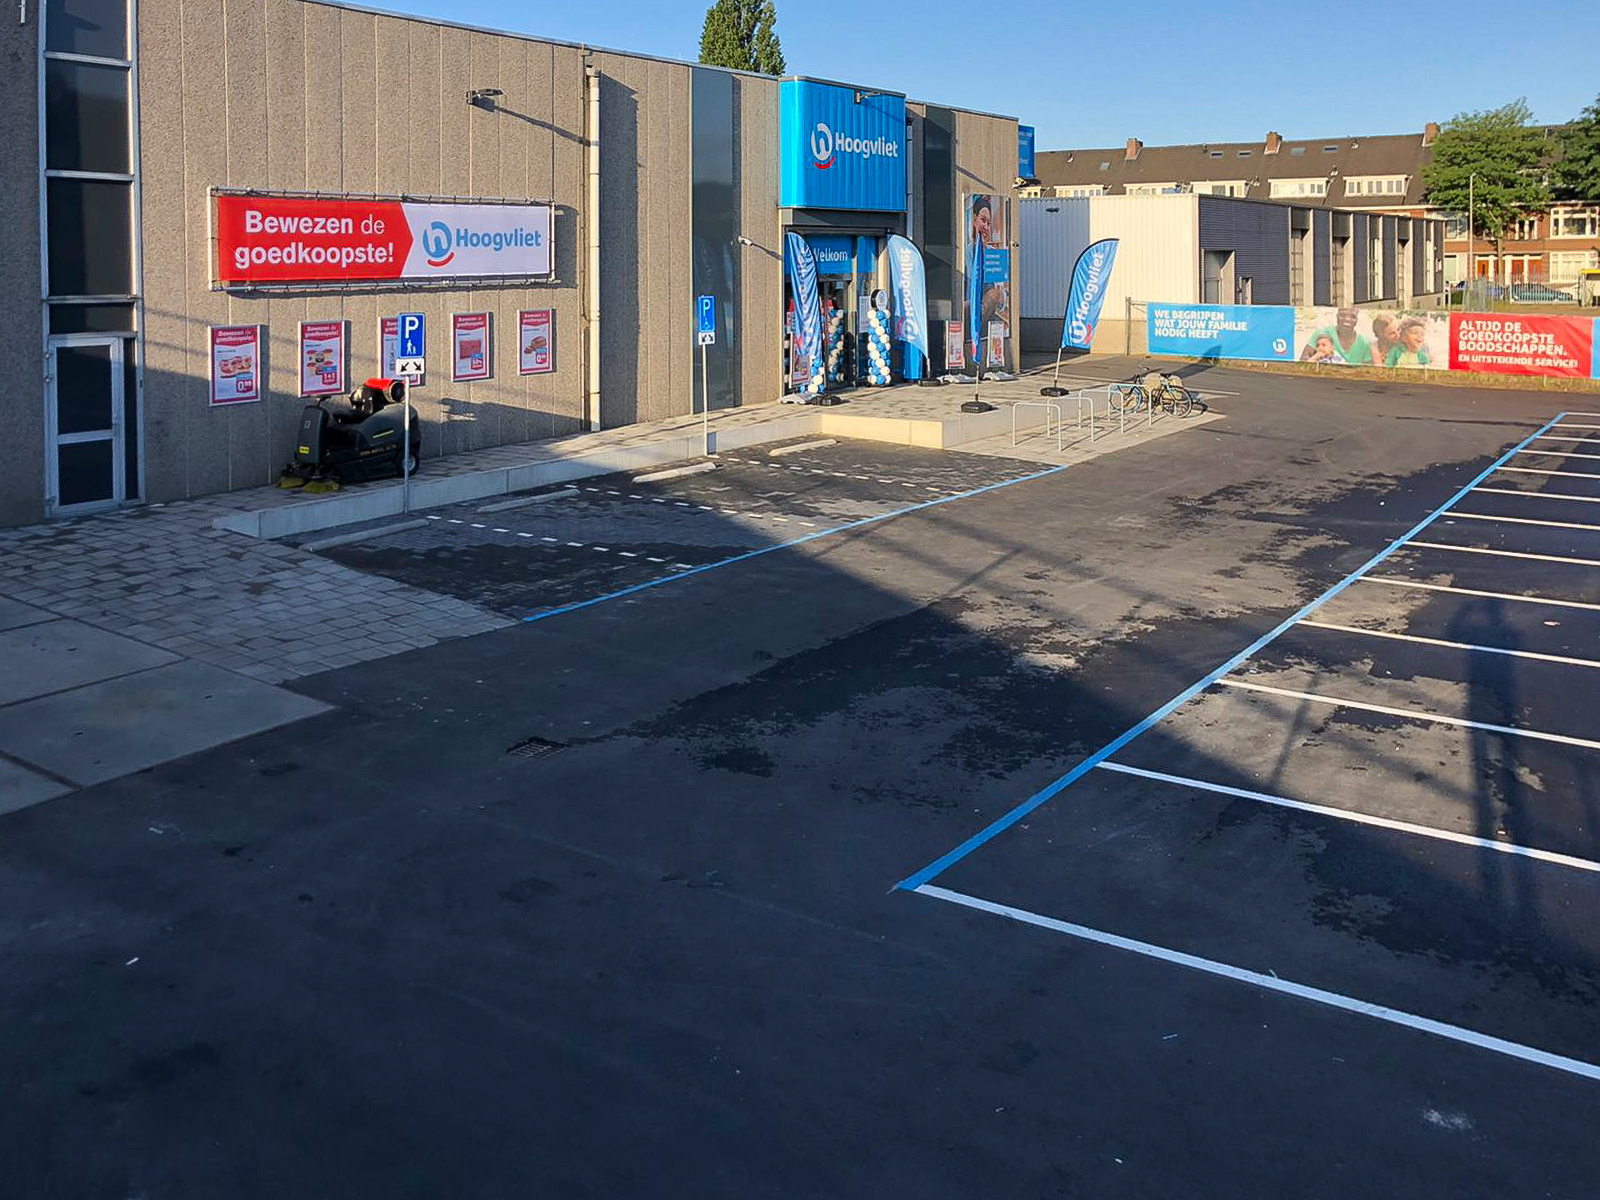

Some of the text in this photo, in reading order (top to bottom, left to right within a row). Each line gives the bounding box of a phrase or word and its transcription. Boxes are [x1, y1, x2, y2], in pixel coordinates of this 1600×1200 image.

[835, 131, 898, 159] Hoogvliet
[245, 210, 385, 235] Bewezen de
[455, 228, 541, 252] Hoogvliet
[234, 242, 394, 269] goedkoopste!
[1074, 251, 1105, 323] Hoogvliet
[703, 299, 711, 316] P
[1154, 309, 1224, 321] WE BEGRIJPEN
[405, 316, 419, 339] P
[1154, 319, 1248, 331] WAT JOUW FAMILIE
[1154, 328, 1219, 339] NODIG HEEFT
[1460, 320, 1522, 332] ALTIJD DE
[1459, 331, 1555, 344] GOEDKOOPSTE
[1472, 356, 1532, 365] UITSTEKENDE
